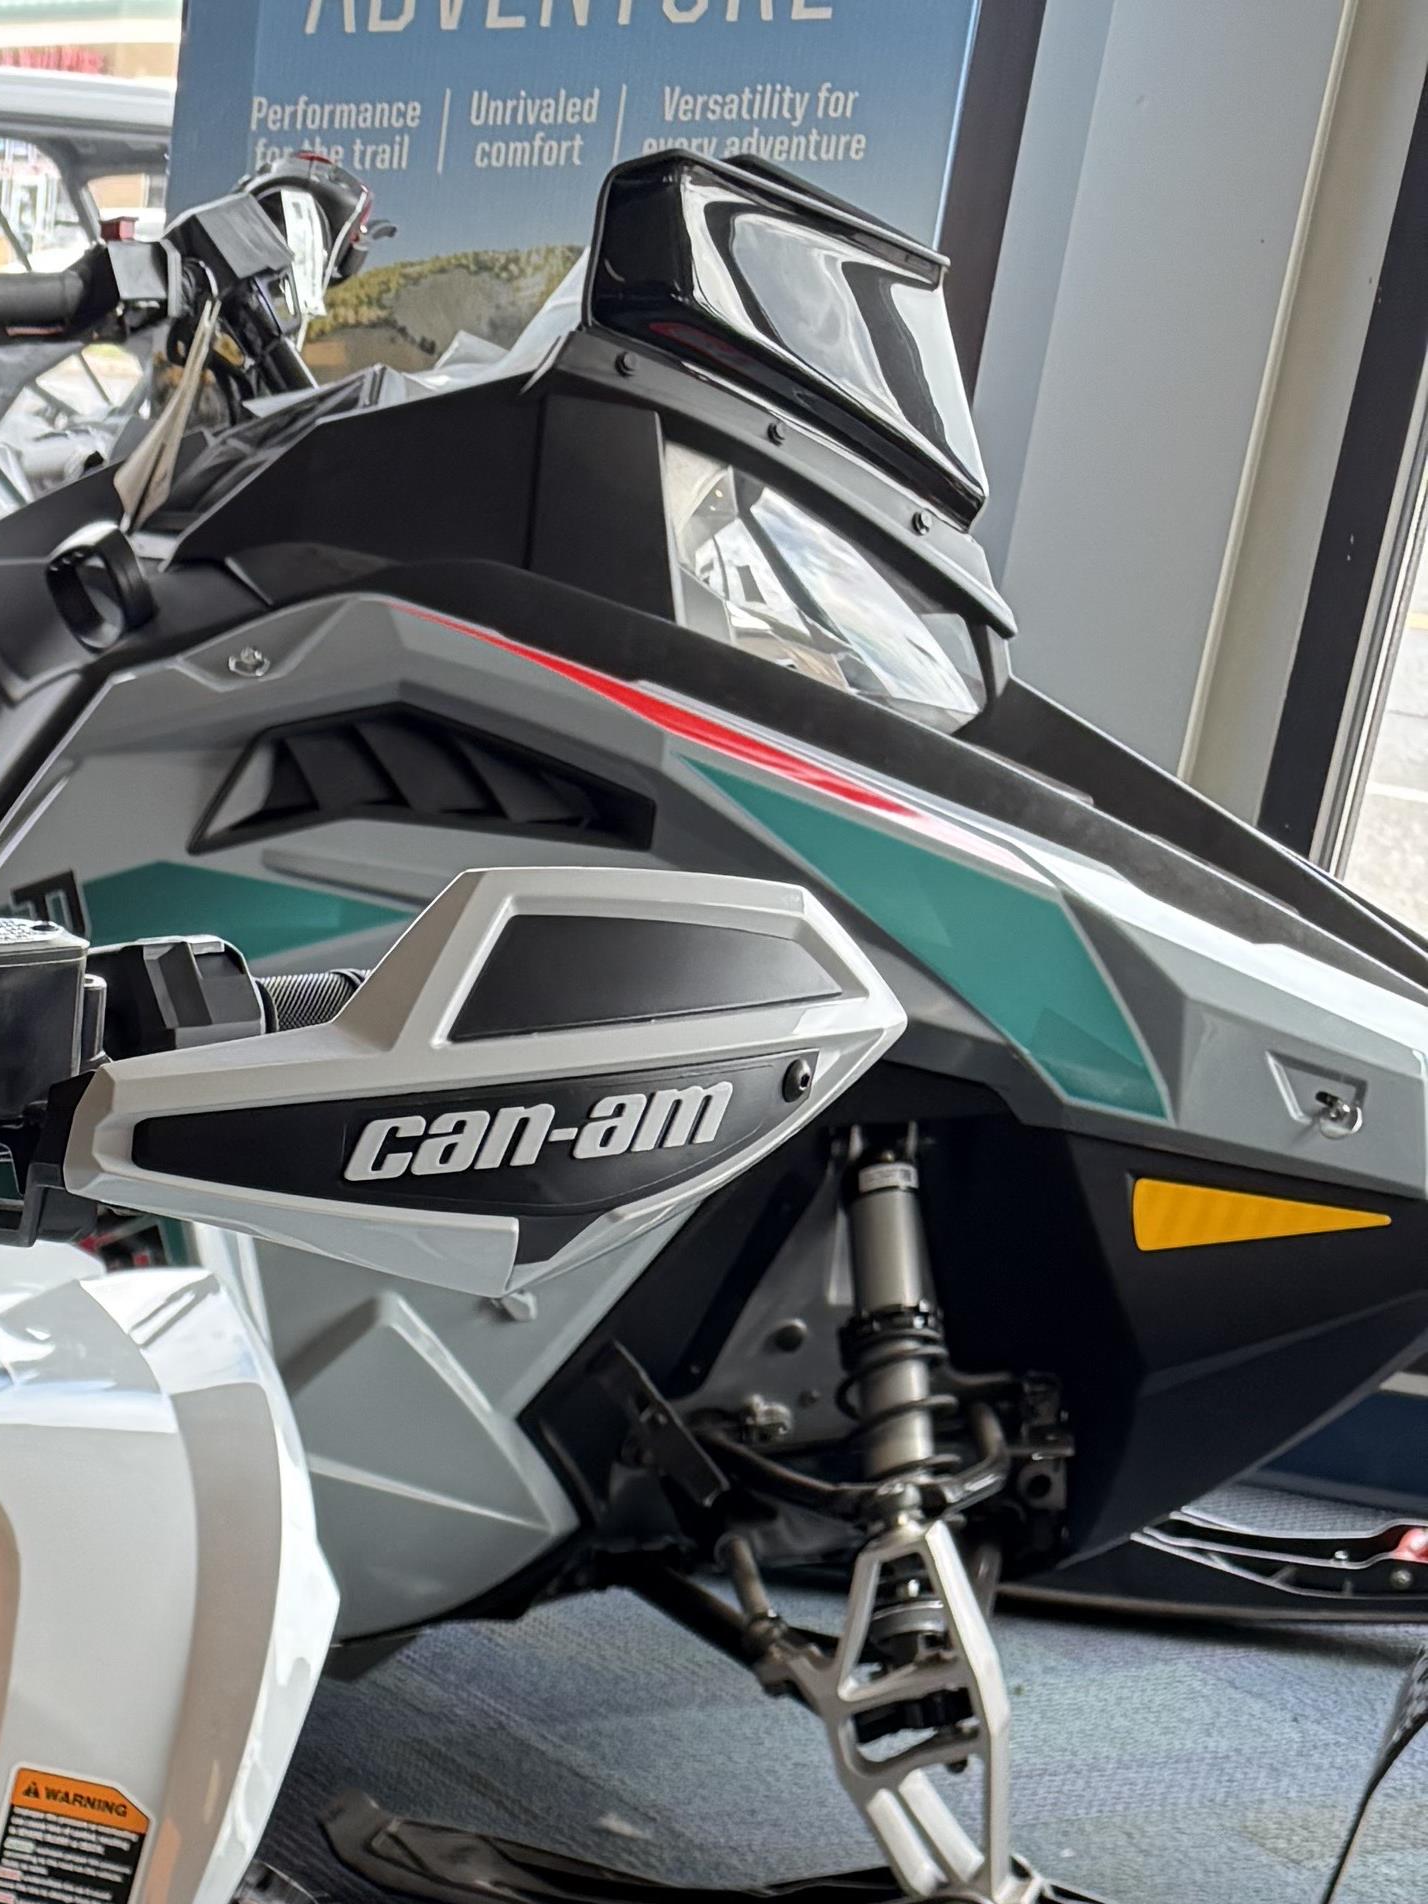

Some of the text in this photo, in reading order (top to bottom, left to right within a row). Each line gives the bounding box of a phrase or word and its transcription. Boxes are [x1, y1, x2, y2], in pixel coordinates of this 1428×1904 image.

[250, 95, 421, 131] Performance
[470, 88, 600, 127] Unrivaled
[663, 82, 859, 126] Versatility for
[353, 134, 409, 170] trail
[475, 133, 584, 168] comfort
[724, 127, 866, 161] adventure
[344, 1081, 733, 1182] can-am
[44, 1786, 128, 1817] WARNING
